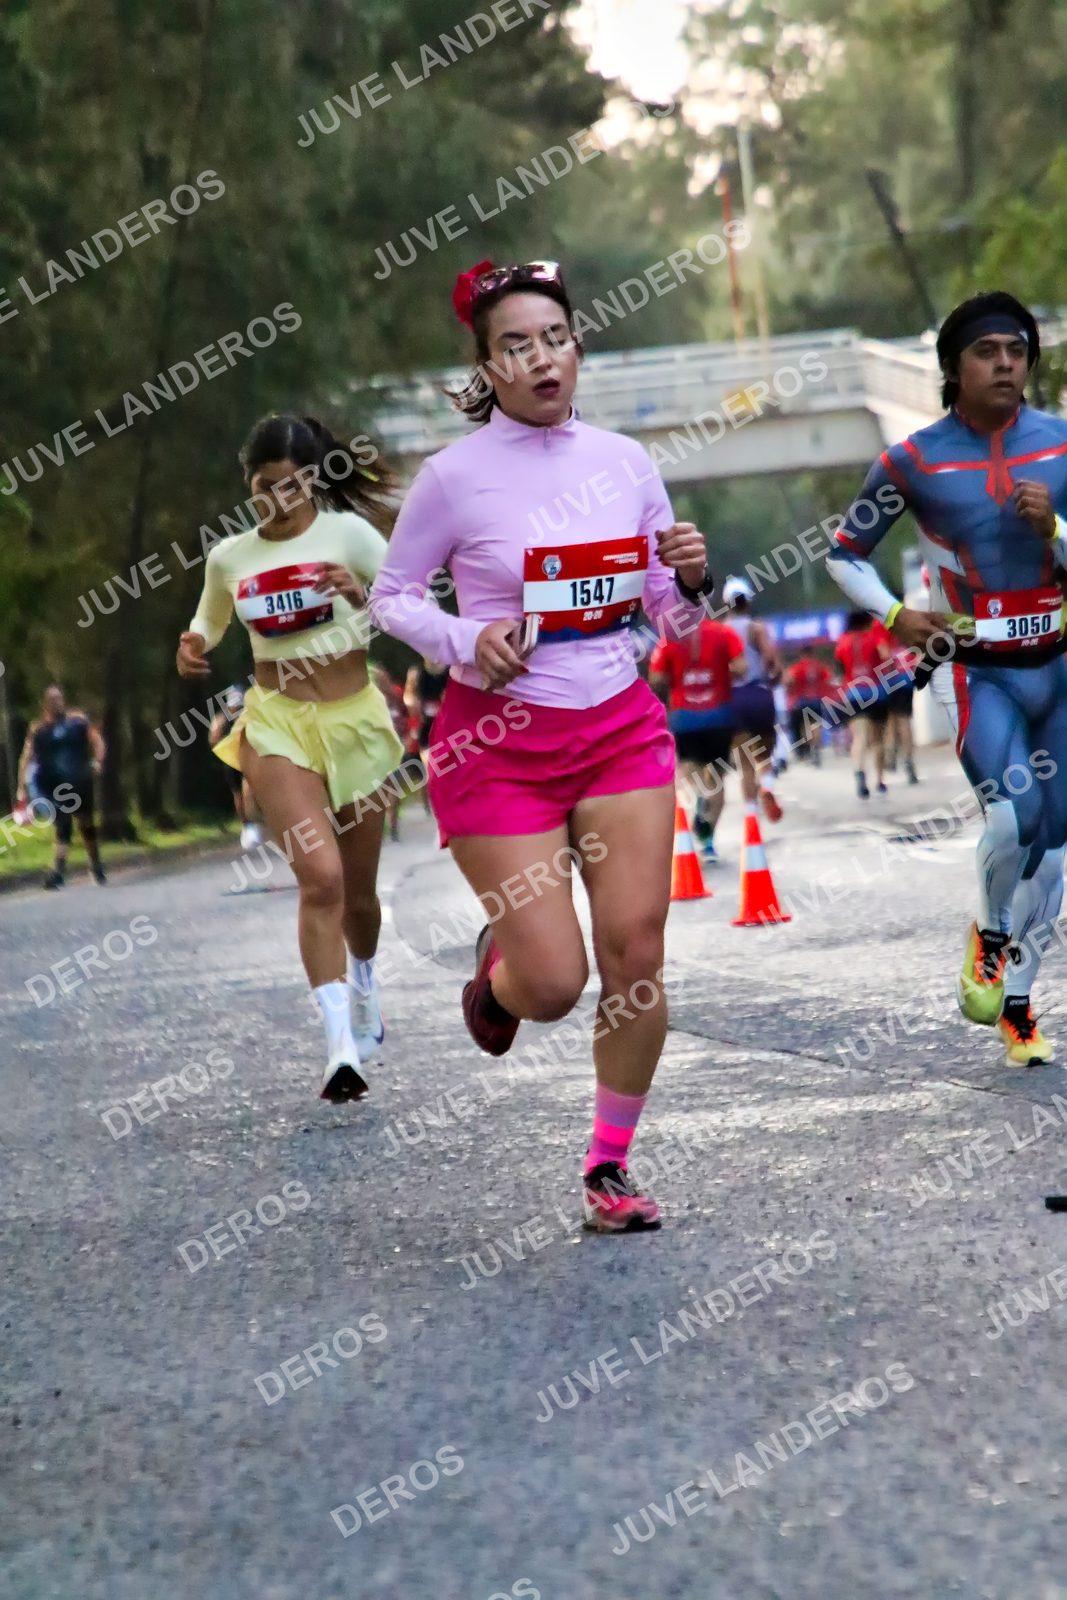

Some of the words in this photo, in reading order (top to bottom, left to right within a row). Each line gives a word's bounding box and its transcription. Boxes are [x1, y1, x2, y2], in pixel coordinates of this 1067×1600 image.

[265, 591, 303, 614] 3416
[570, 577, 614, 607] 1547
[1007, 615, 1051, 638] 3050
